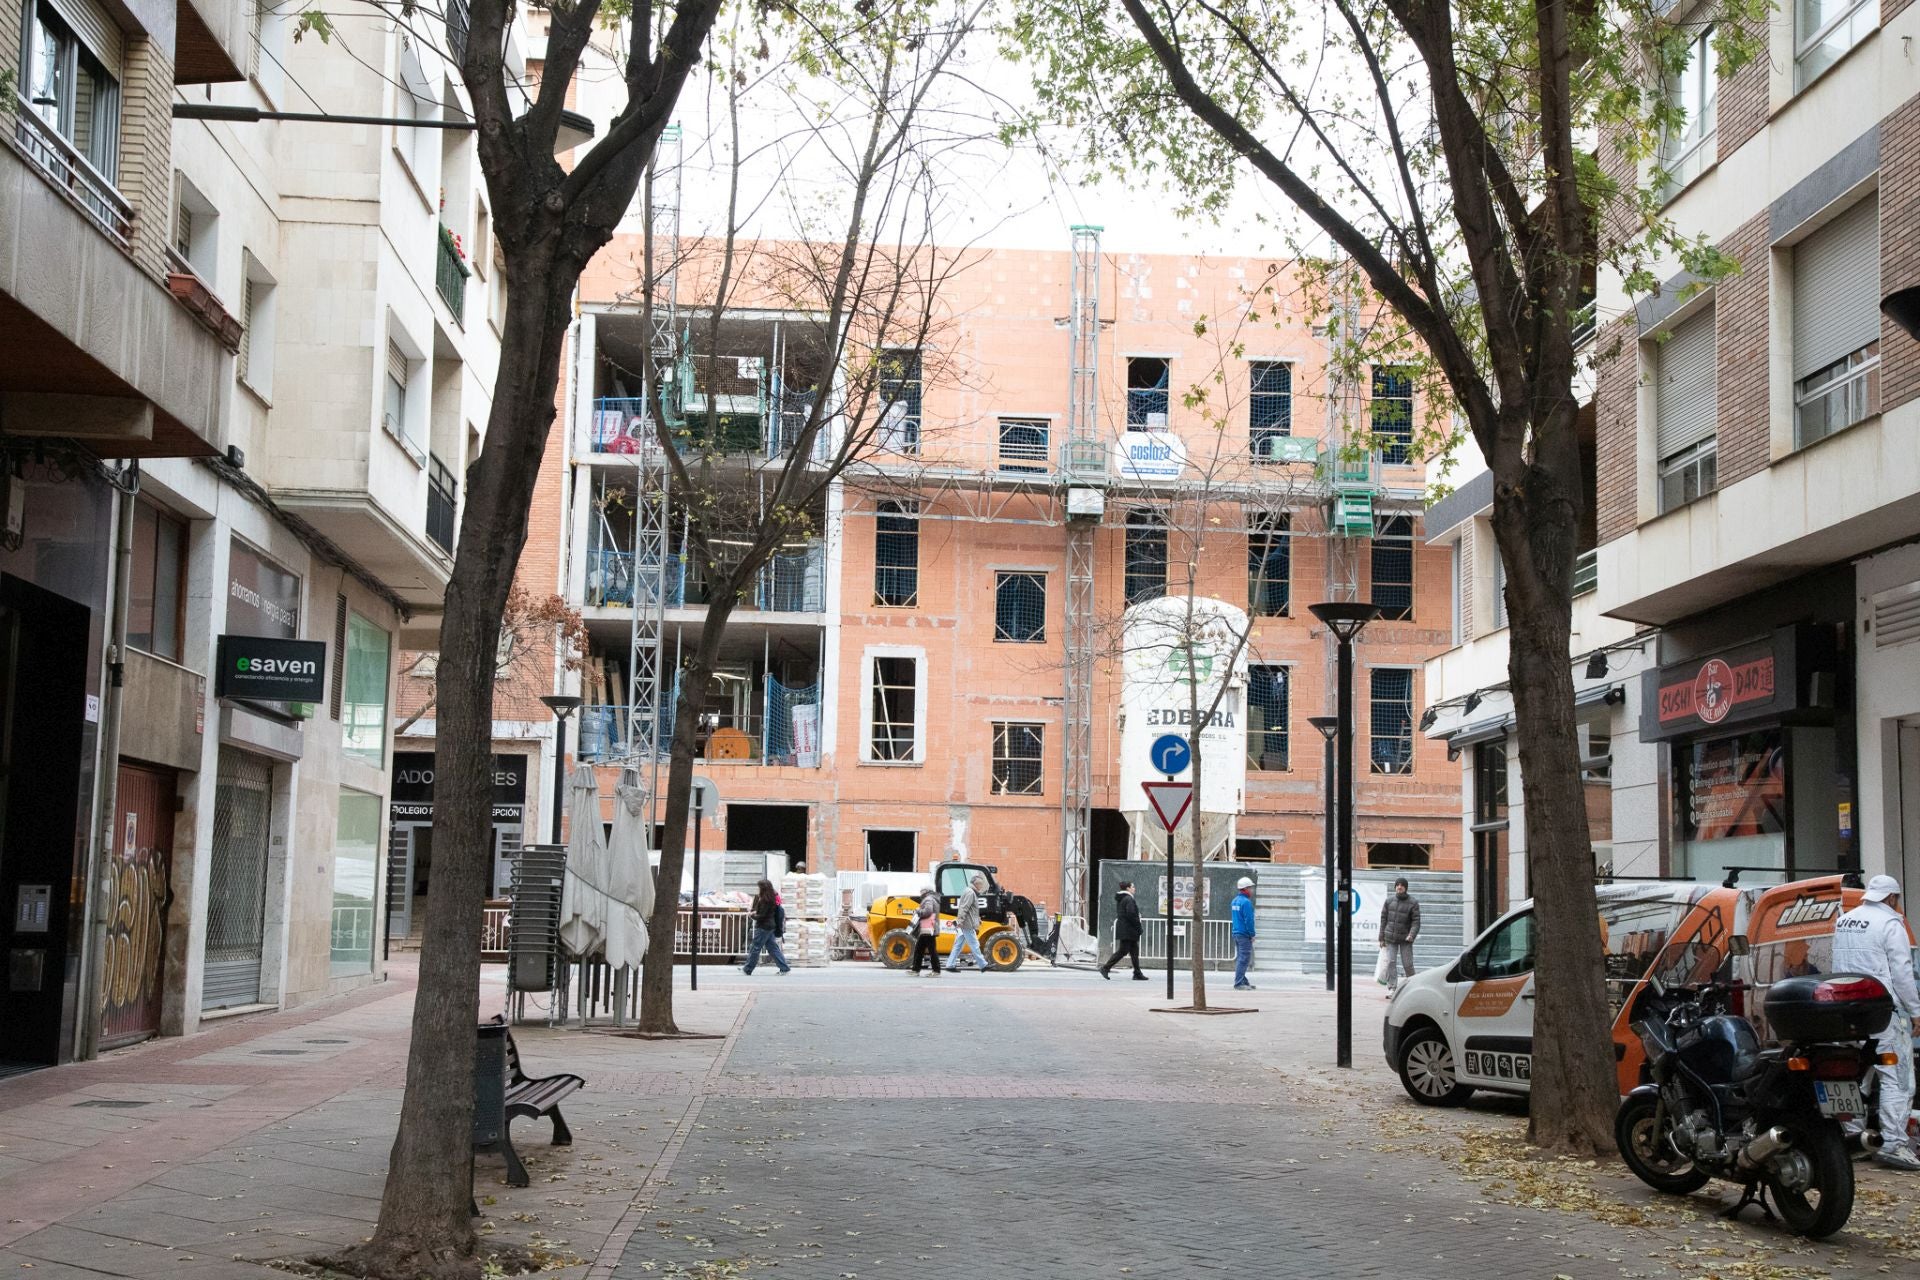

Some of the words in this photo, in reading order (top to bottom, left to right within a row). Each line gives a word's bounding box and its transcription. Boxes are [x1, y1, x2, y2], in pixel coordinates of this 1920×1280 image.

[236, 657, 316, 675] esaven
[1707, 663, 1719, 676] Bar
[1736, 666, 1759, 696] DAO
[1662, 687, 1691, 715] SUSHI
[1700, 703, 1714, 720] TAKE
[1714, 697, 1729, 719] AWAY
[950, 897, 988, 909] JB
[1848, 1084, 1856, 1097] P
[1828, 1098, 1860, 1112] 7881
